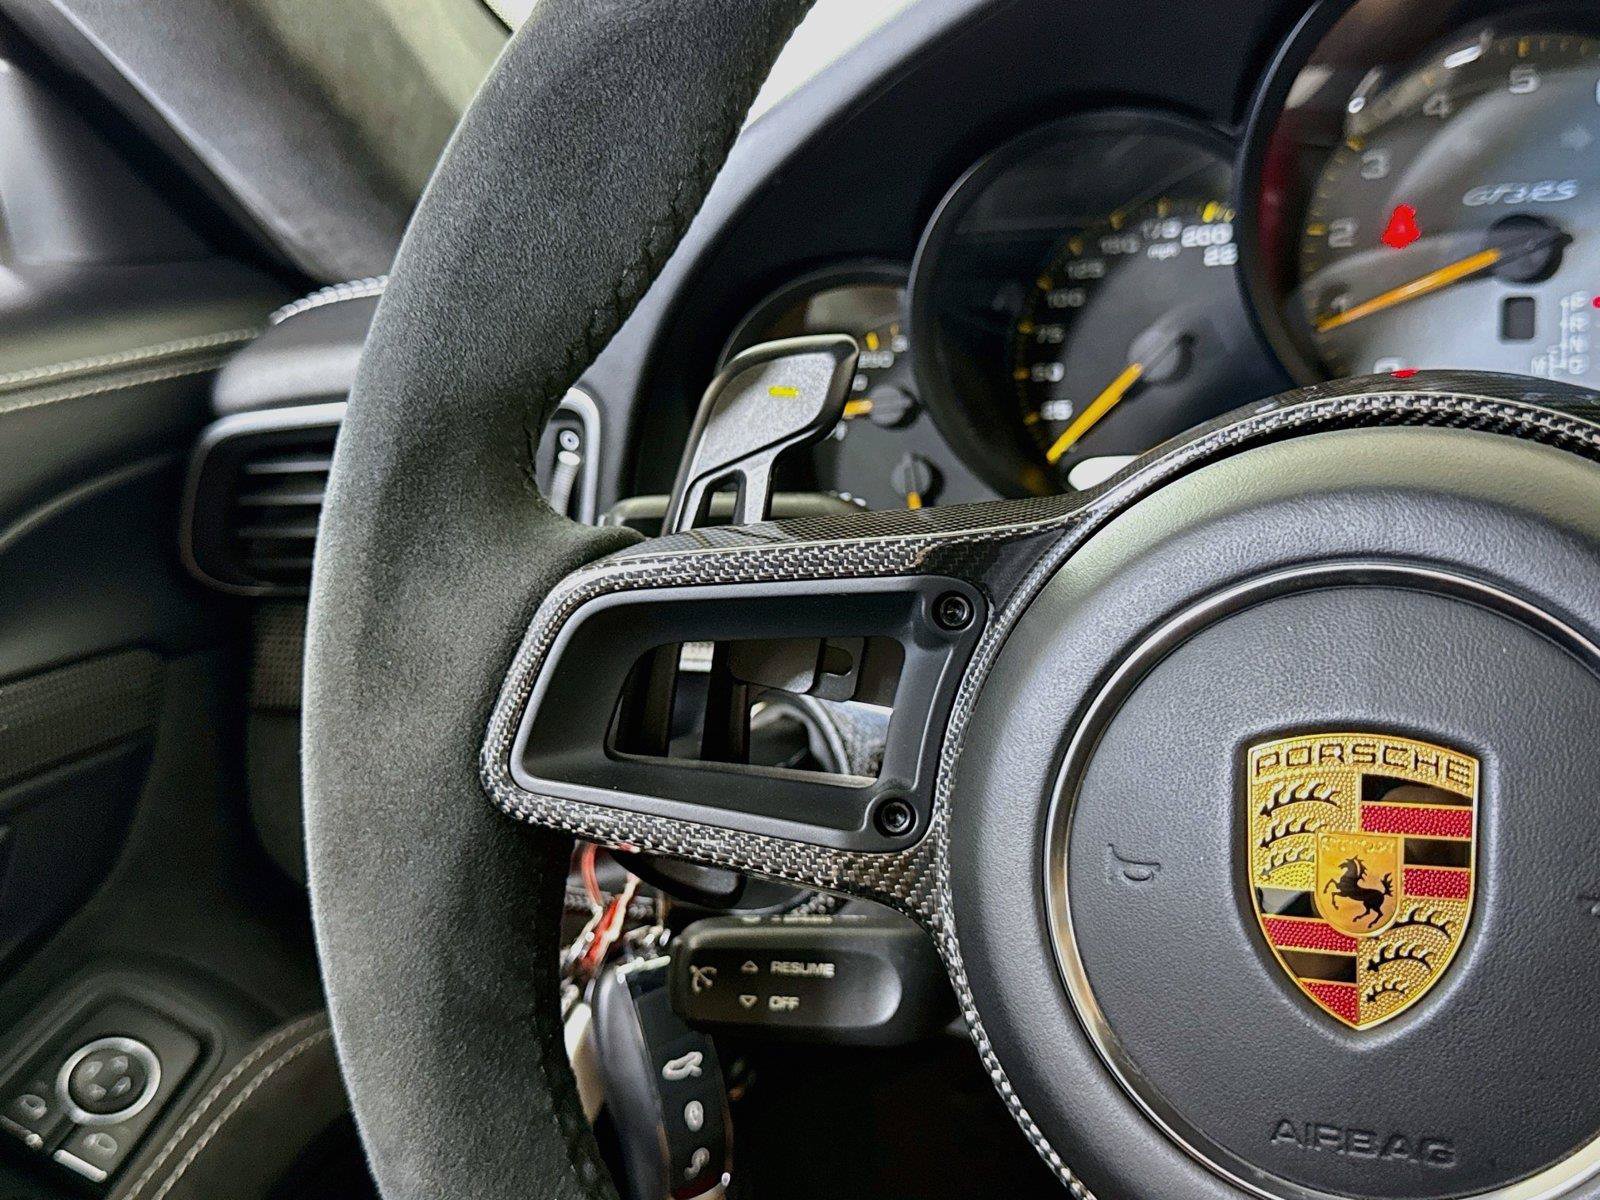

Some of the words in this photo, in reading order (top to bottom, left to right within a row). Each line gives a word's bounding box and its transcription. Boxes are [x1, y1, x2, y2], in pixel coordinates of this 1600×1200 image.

[1508, 66, 1541, 95] 5
[1422, 93, 1452, 119] 4
[1328, 218, 1358, 249] 2
[1255, 743, 1471, 789] PORSCHE
[770, 960, 835, 978] RESUME
[769, 995, 800, 1011] OFF
[1270, 1118, 1456, 1168] AIRBAG
